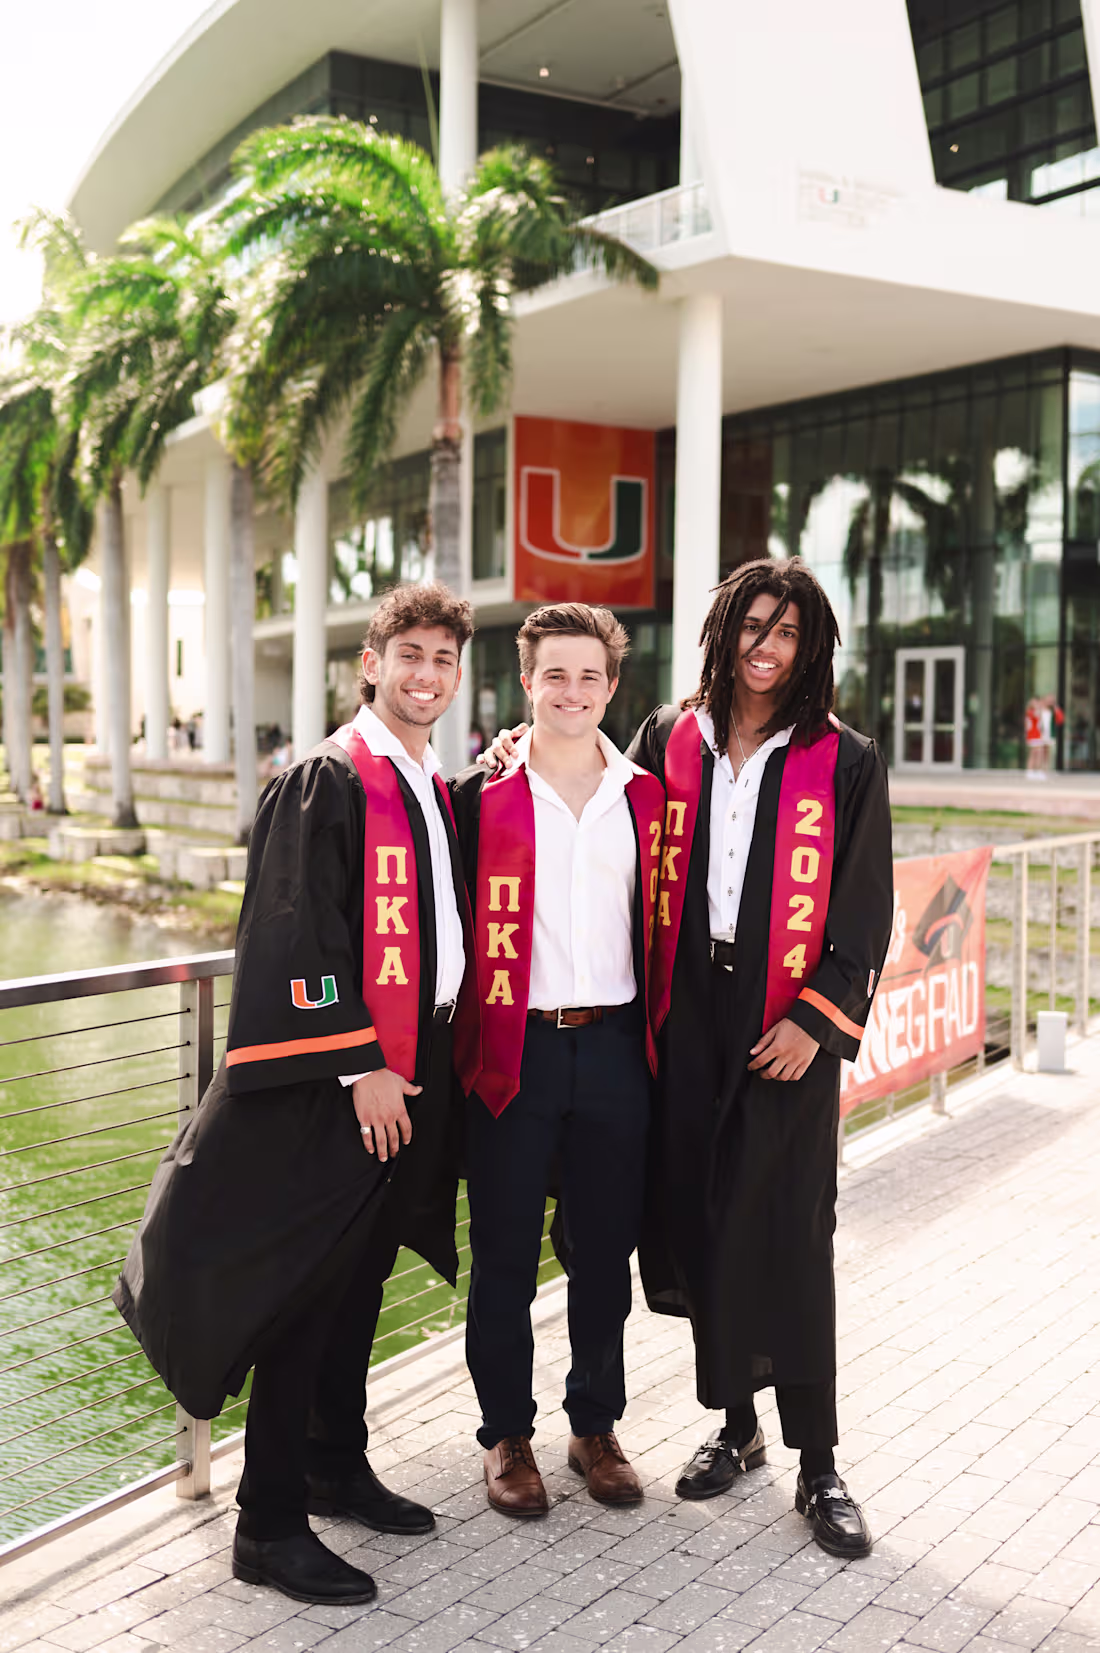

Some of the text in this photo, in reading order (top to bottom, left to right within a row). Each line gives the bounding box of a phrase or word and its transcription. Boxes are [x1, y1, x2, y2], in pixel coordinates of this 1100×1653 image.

[520, 465, 649, 565] U
[783, 799, 824, 979] 2024
[290, 974, 339, 1010] U
